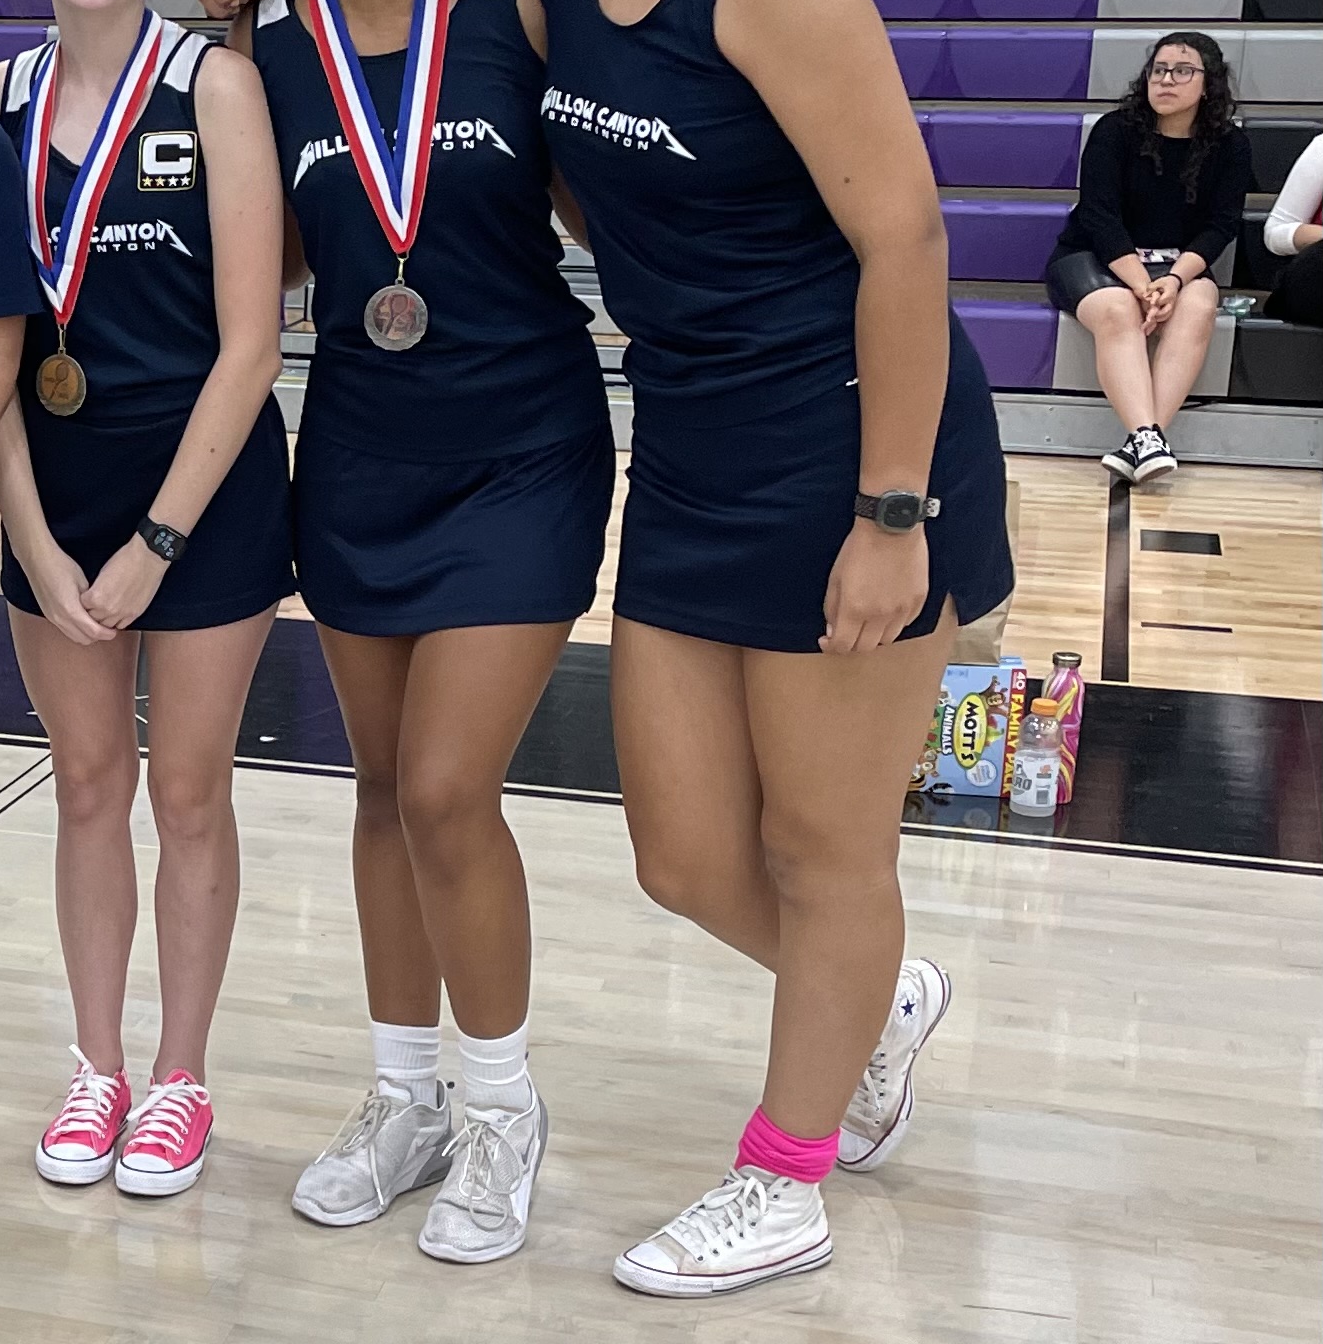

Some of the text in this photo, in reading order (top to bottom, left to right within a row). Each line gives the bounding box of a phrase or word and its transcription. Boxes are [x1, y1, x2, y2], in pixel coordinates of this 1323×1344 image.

[548, 111, 650, 151] BADMINTON
[142, 133, 194, 175] C
[1015, 671, 1026, 690] 40
[942, 705, 956, 755] ANIMALS
[1007, 694, 1024, 750] FAMILY
